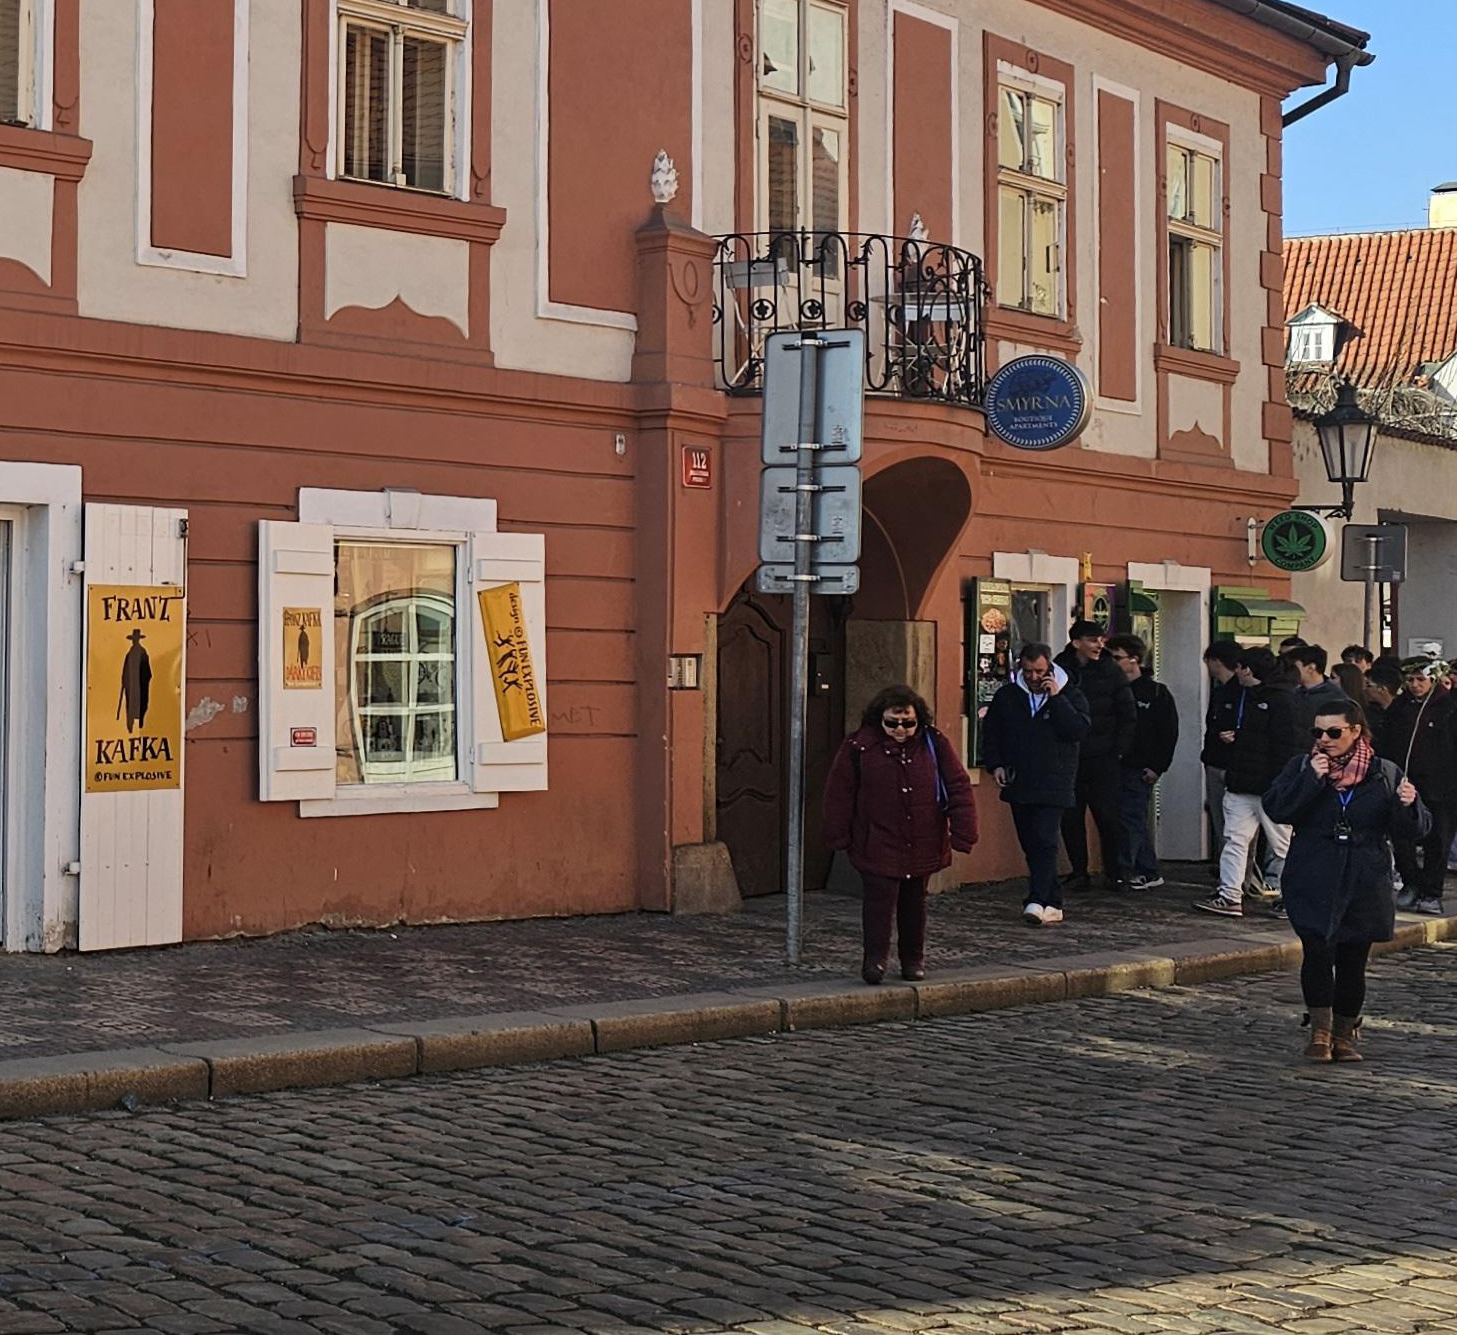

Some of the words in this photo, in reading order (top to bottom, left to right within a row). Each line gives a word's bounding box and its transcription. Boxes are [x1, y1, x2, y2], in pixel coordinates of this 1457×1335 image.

[996, 395, 1071, 412] SMYRNA
[1009, 421, 1058, 430] APARTMENTS
[692, 451, 707, 469] 112
[1269, 514, 1291, 530] WEED
[1295, 513, 1319, 529] SHOP
[1275, 556, 1315, 569] COMPANY
[102, 595, 170, 622] FRANZ
[509, 592, 520, 623] design
[515, 640, 529, 664] FUN
[522, 665, 541, 727] EXPLOSIVE
[95, 736, 173, 764] KAFKA
[122, 770, 172, 781] EXPLOSIVE
